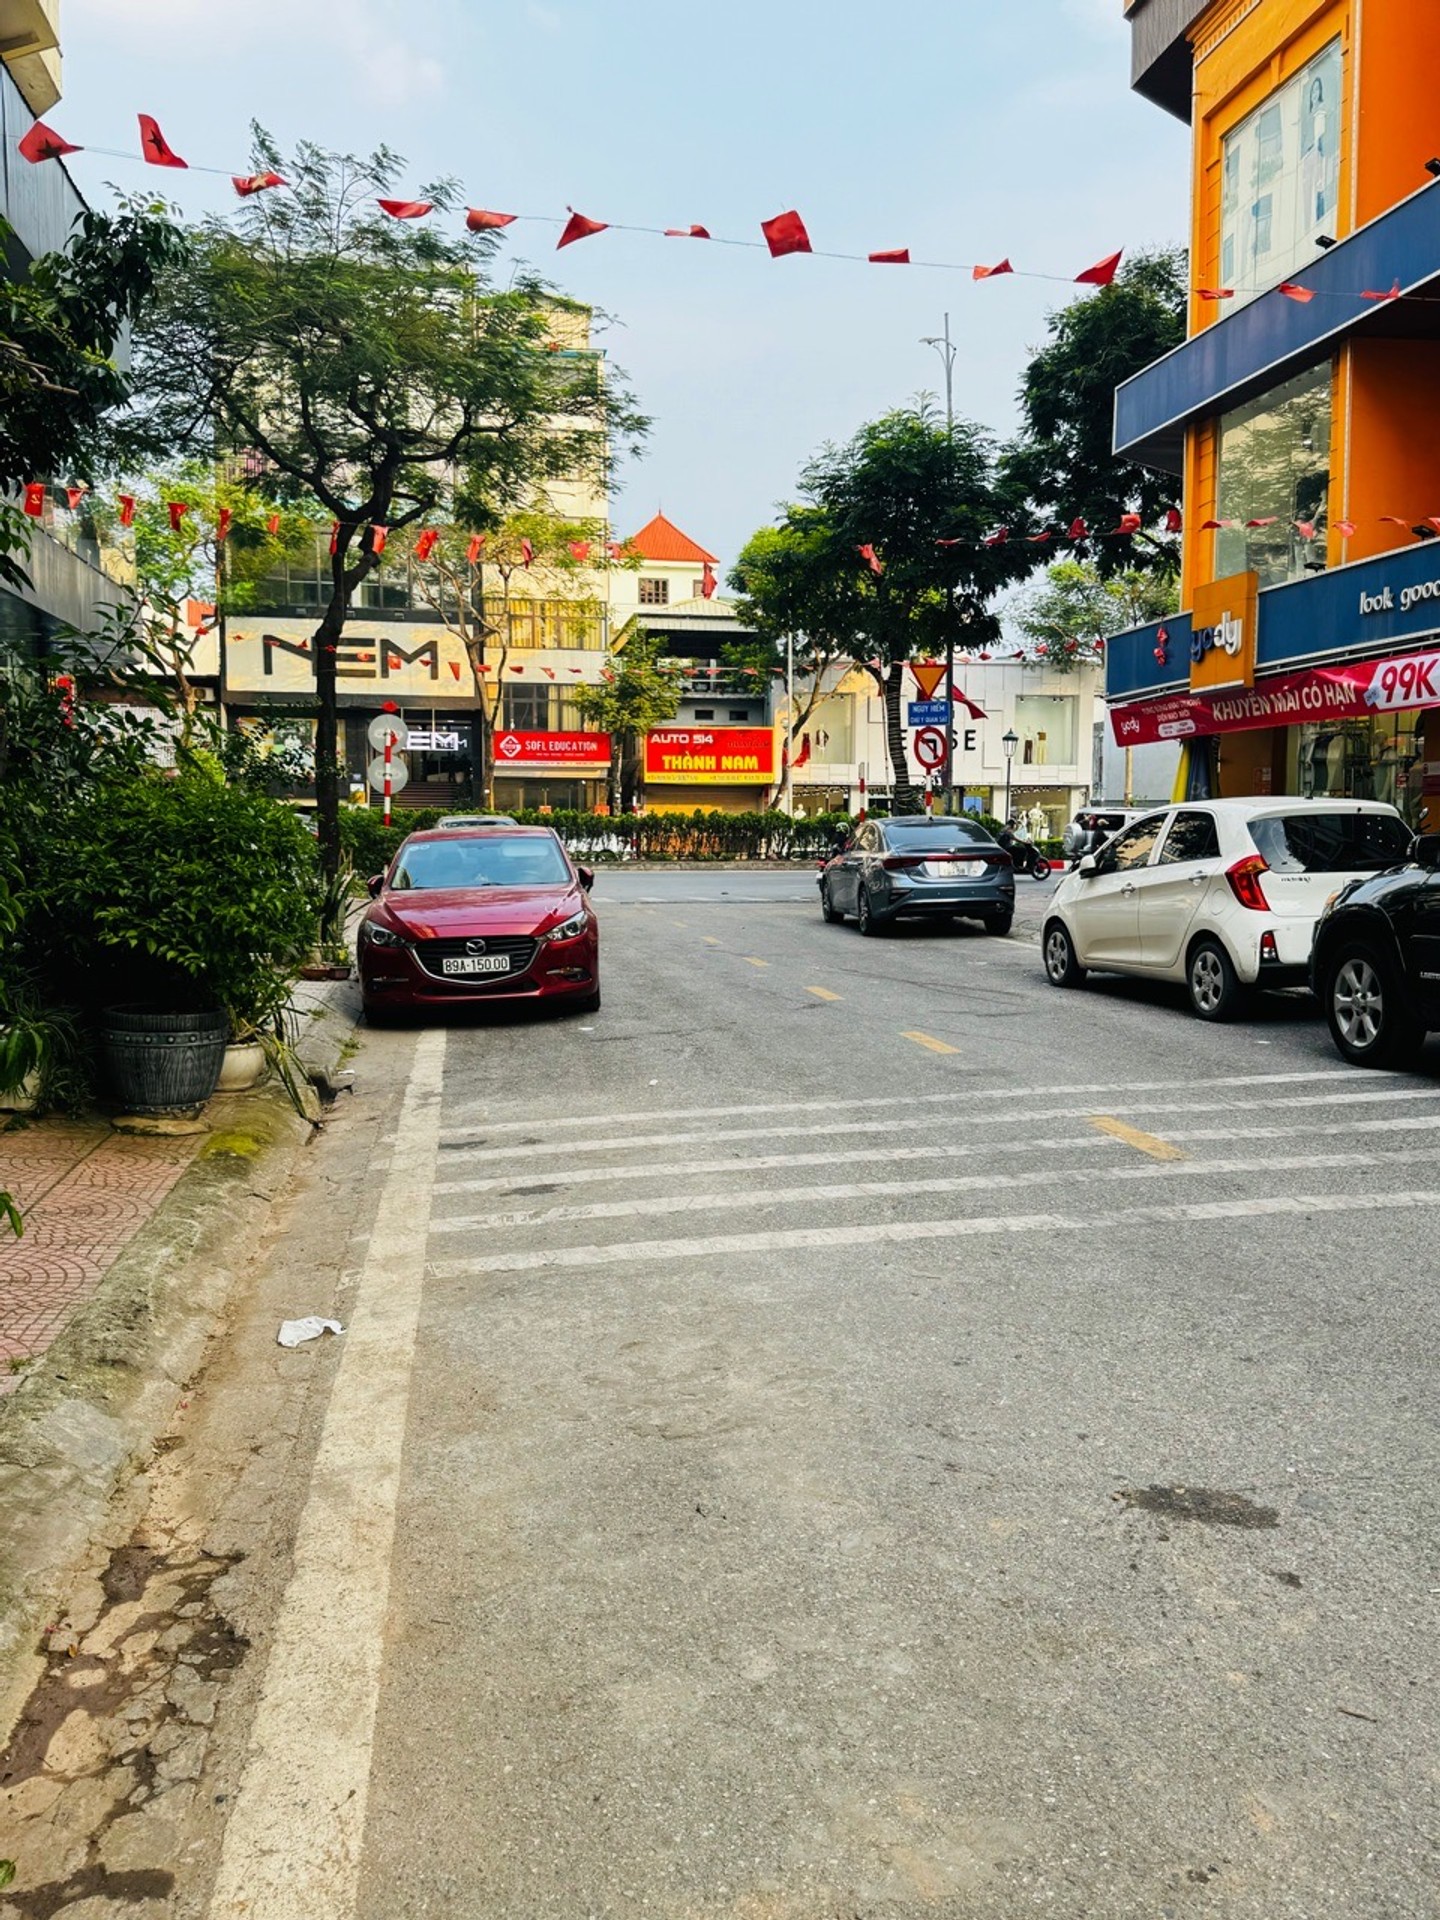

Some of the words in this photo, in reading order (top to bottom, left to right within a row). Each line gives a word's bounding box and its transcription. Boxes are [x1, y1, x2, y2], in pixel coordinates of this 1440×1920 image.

[1359, 586, 1394, 614] look
[1190, 610, 1243, 662] yody
[263, 634, 438, 680] NEM
[1381, 659, 1439, 703] 99K
[1304, 680, 1322, 709] CÓ
[1324, 680, 1356, 711] HẠN
[650, 733, 690, 744] AUTO
[1121, 716, 1140, 735] yody
[525, 740, 546, 751] SOFL
[548, 741, 598, 751] EDUCATION
[662, 750, 716, 770] THÀNH
[721, 755, 758, 770] NAM
